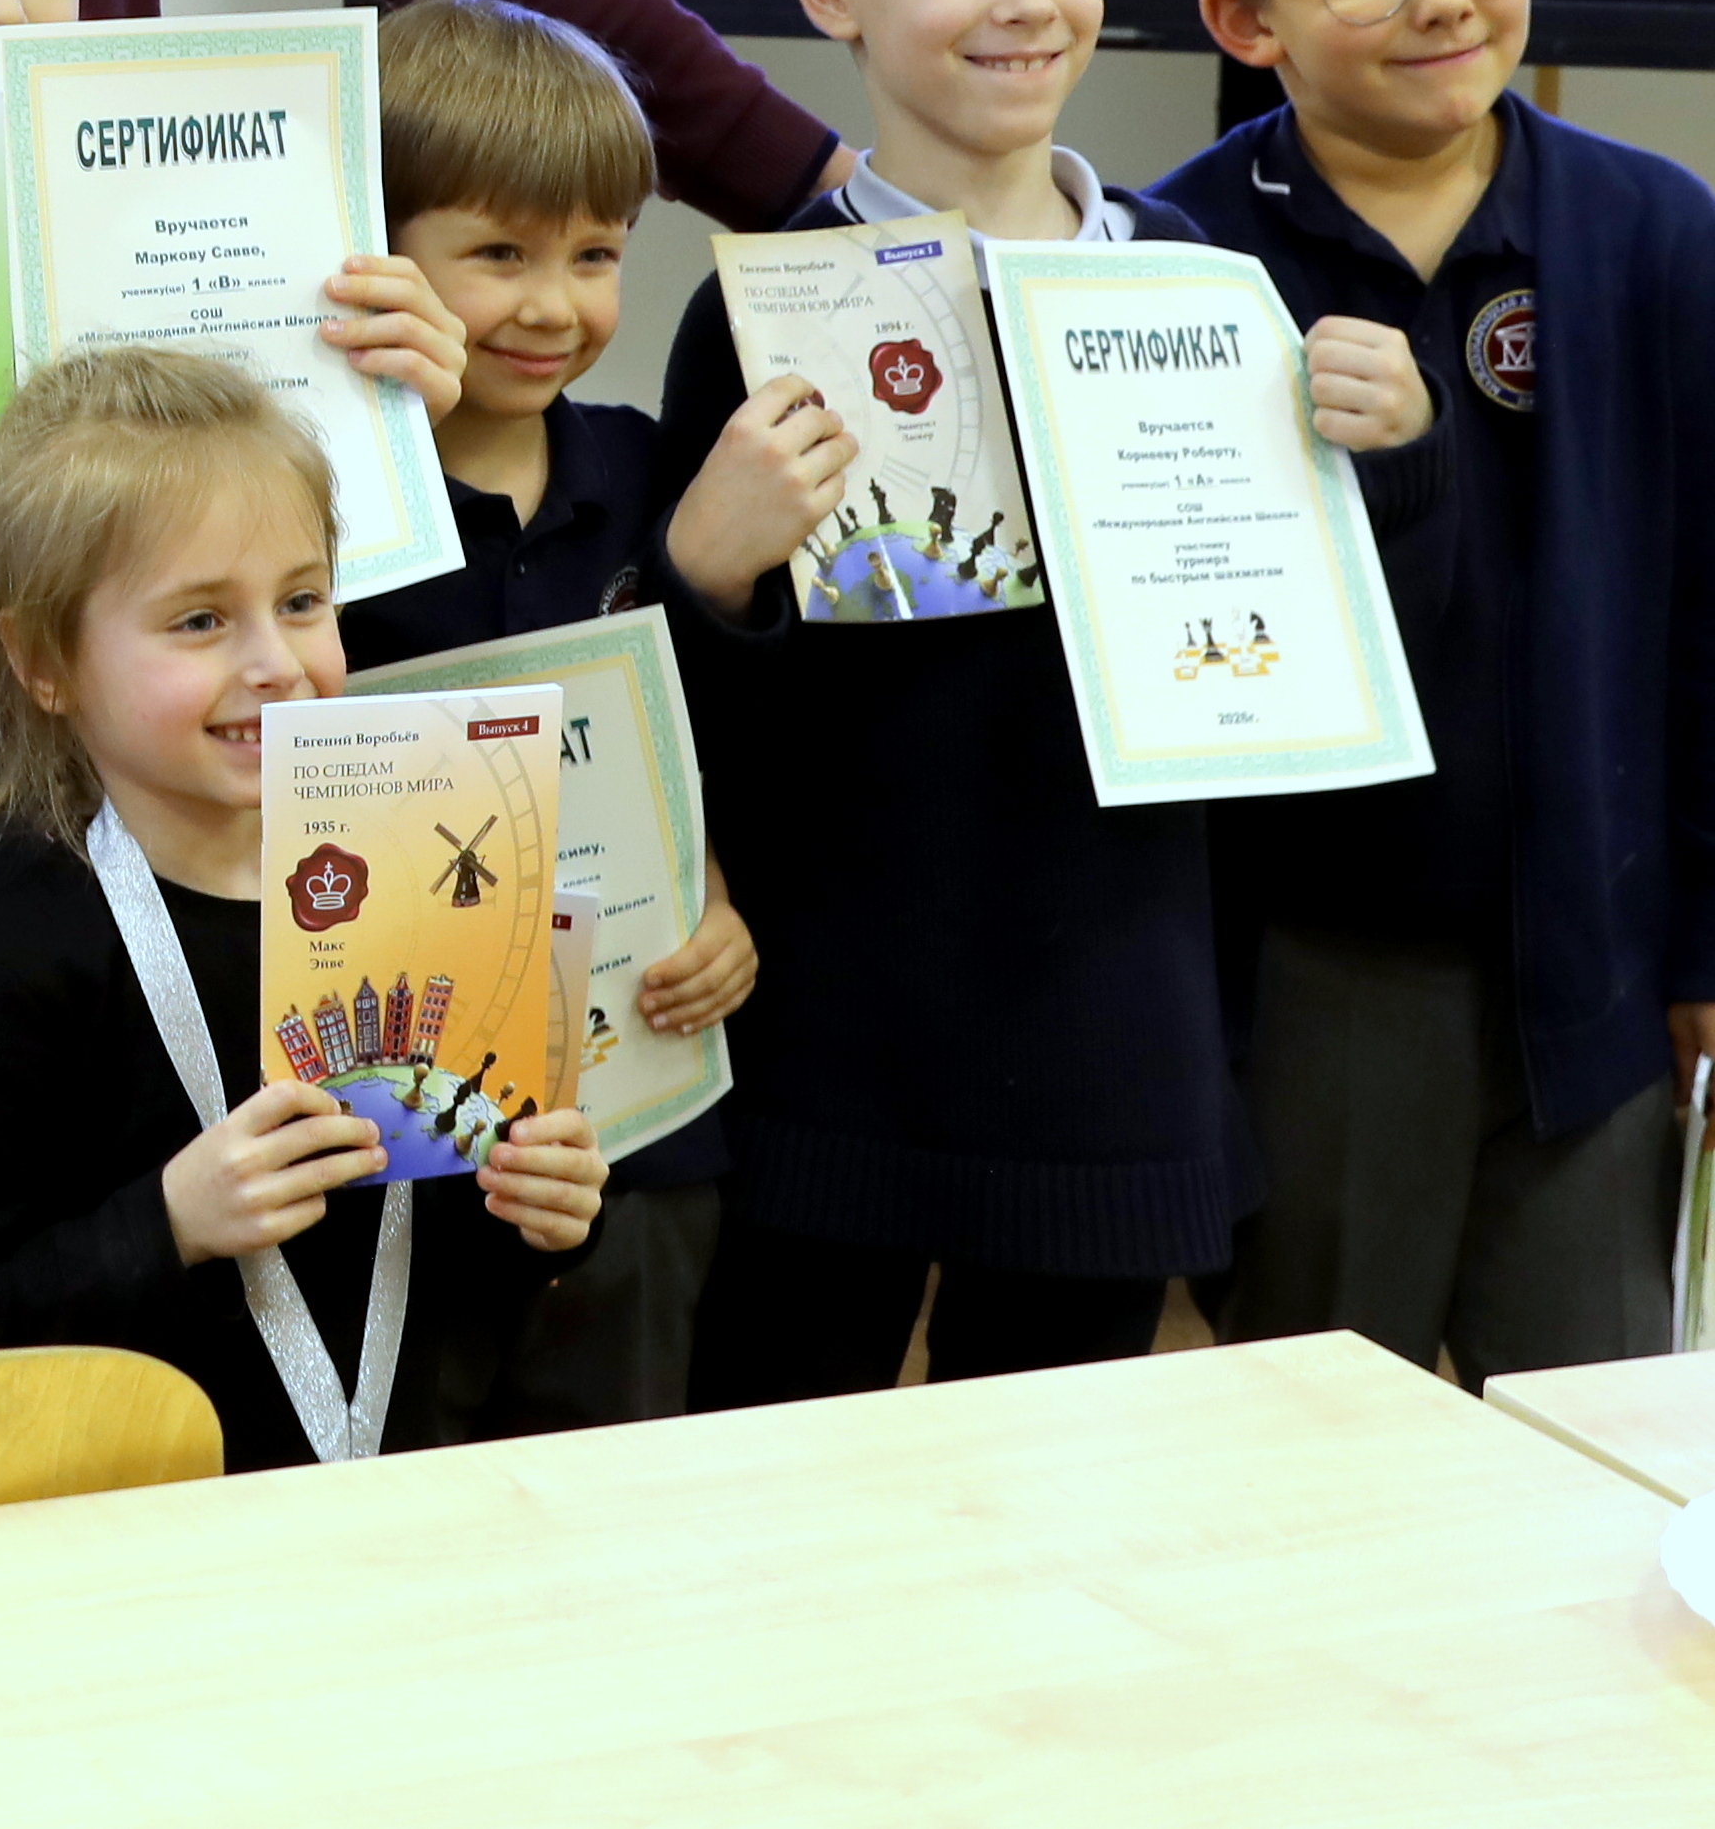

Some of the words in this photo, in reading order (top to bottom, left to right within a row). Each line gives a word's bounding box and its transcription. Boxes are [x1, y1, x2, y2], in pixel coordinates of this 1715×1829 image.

[77, 111, 286, 168] СЕРТИФИКАТ
[155, 218, 248, 235] Вручается
[136, 251, 205, 265] Маркову
[212, 247, 265, 258] Савве,
[191, 308, 222, 319] СОШ
[201, 320, 280, 333] Английская
[479, 724, 519, 739] Выпуск
[295, 737, 351, 747] Евгений
[357, 732, 419, 747] Воробьёв
[294, 766, 319, 779] ПО
[323, 761, 393, 779] СЛЕДАМ
[294, 782, 402, 799] ЧЕМПИОНОВ
[407, 778, 453, 793] МИРА
[306, 821, 335, 834] 1935
[310, 940, 343, 952] Макс
[310, 953, 343, 969] Эйве
